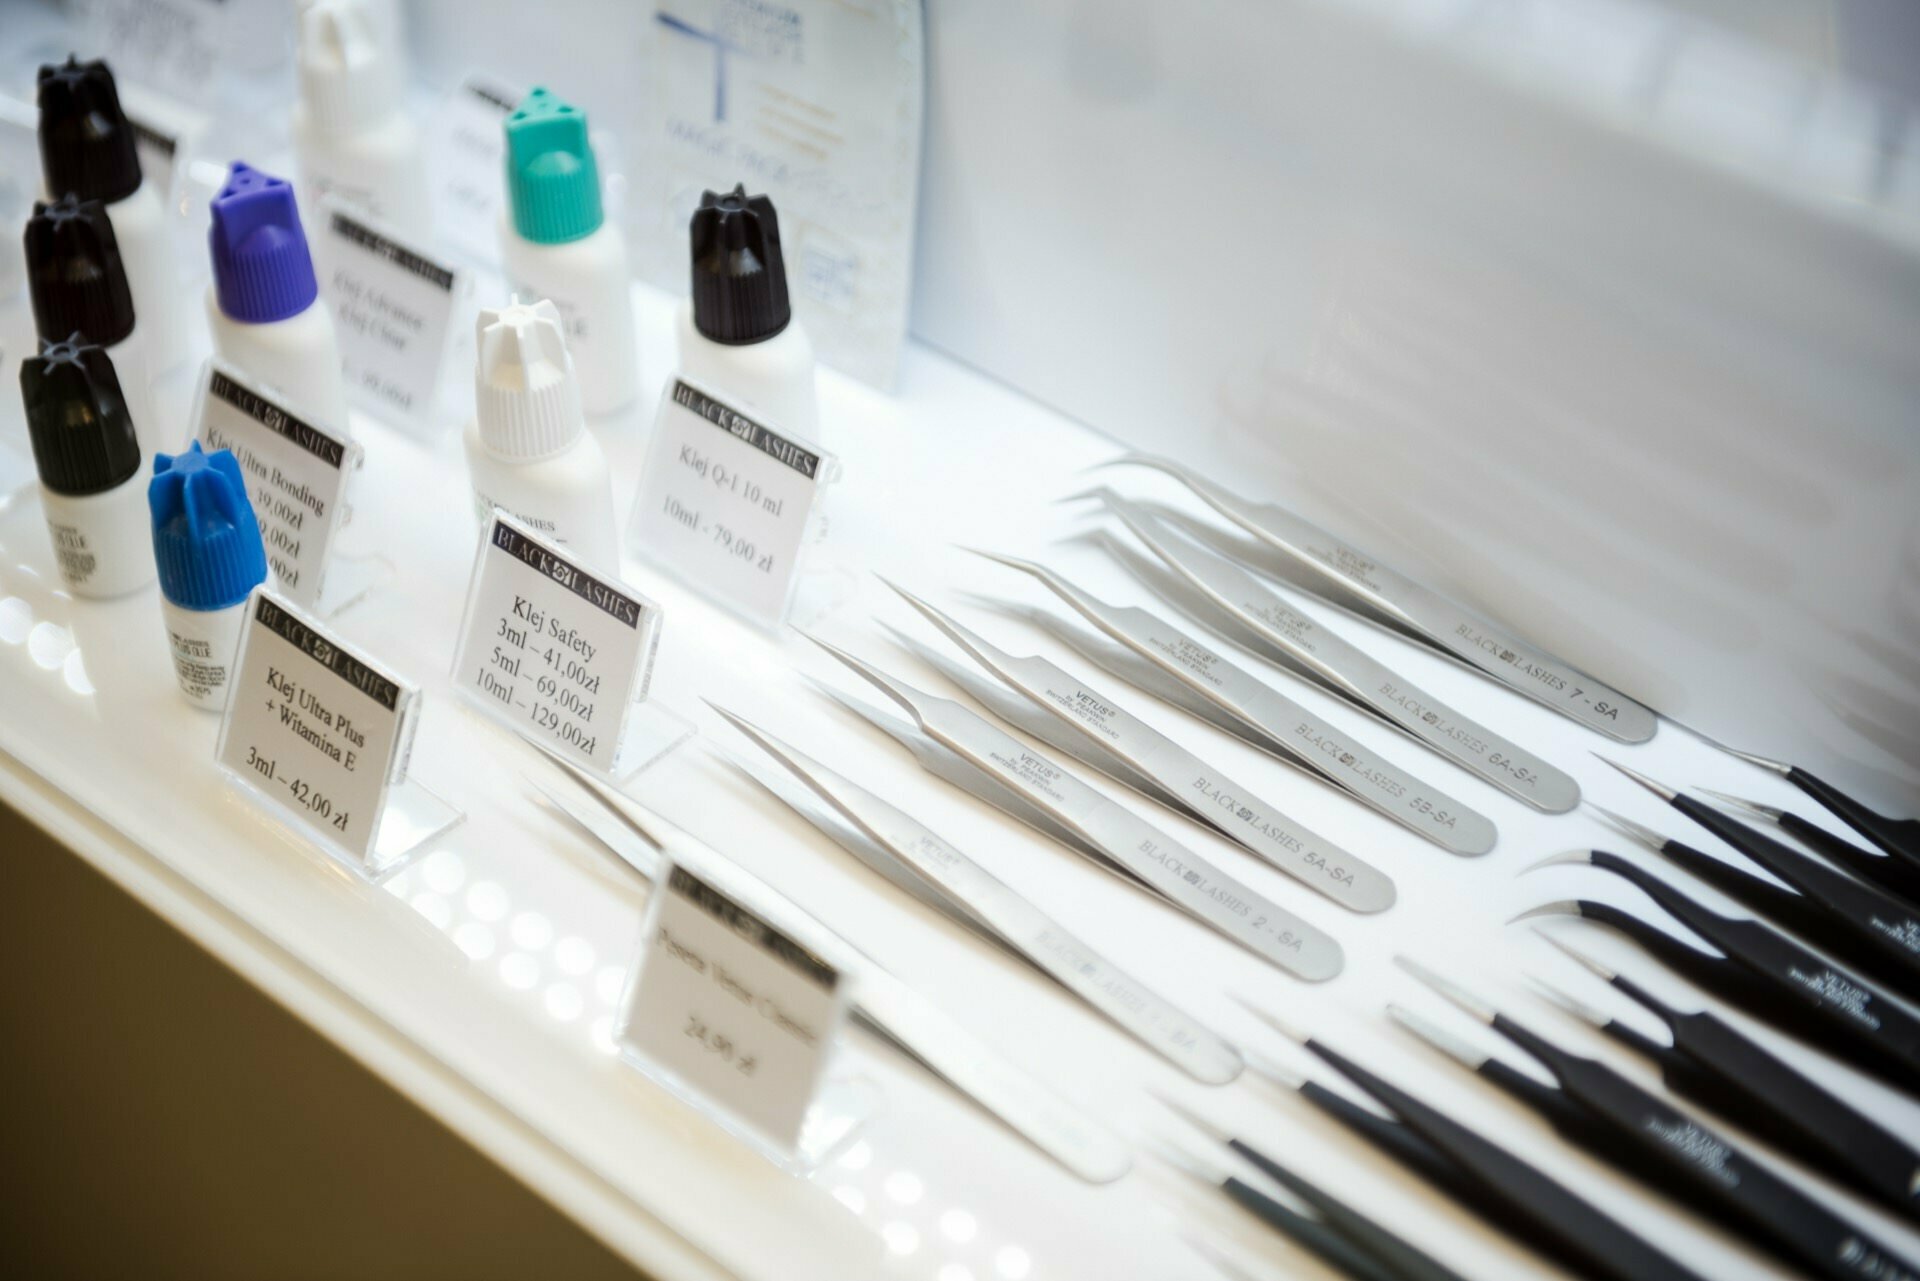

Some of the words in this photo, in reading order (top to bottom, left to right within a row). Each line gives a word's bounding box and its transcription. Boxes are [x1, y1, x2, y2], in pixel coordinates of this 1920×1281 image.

[213, 375, 266, 421] BLACK
[279, 409, 340, 465] LASHES
[676, 385, 733, 431] BLACK
[750, 424, 815, 476] LASHES
[270, 469, 324, 516] Bonding
[679, 445, 709, 479] Klej
[743, 479, 761, 504] 10
[762, 498, 784, 518] ml
[260, 520, 300, 559] 9,00zł
[497, 527, 553, 576] BLACK
[569, 567, 637, 624] LASHES
[662, 495, 701, 532] 10ml
[713, 523, 755, 563] 79,00
[757, 554, 775, 574] zł
[260, 602, 315, 653] BLACK
[330, 648, 394, 706] LASHES
[497, 618, 528, 650] 3ml
[543, 647, 601, 695] 41,00zł
[512, 595, 545, 632] Klej
[548, 618, 597, 663] Safety
[266, 667, 297, 703] Klej
[300, 687, 332, 727] Ultra
[336, 714, 366, 749] Plus
[476, 667, 514, 705] 10ml
[530, 702, 597, 755] 129,00zł
[491, 646, 521, 677] 5ml
[537, 675, 594, 723] 69,00zł
[1455, 623, 1502, 656] BLACK
[1511, 656, 1568, 691] LASHES
[1569, 688, 1584, 699] 7
[1594, 702, 1620, 720] SA
[265, 700, 276, 712] +
[279, 705, 342, 762] Witamina
[344, 752, 356, 772] E
[1294, 723, 1341, 760] BLACK
[1351, 759, 1407, 799] LASHES
[1409, 796, 1458, 830] 5B-SA
[1378, 681, 1425, 718] BLACK
[1434, 717, 1486, 755] LASHES
[1488, 752, 1539, 788] 6A-SA
[246, 746, 276, 780] 3ml
[289, 779, 332, 820] 42,00
[332, 812, 349, 832] zł
[1192, 776, 1239, 815] BLACK
[1249, 814, 1304, 853] LASHES
[1303, 850, 1356, 888] 5A-SA
[1138, 839, 1188, 879] BLACK
[1197, 879, 1253, 919] LASHES
